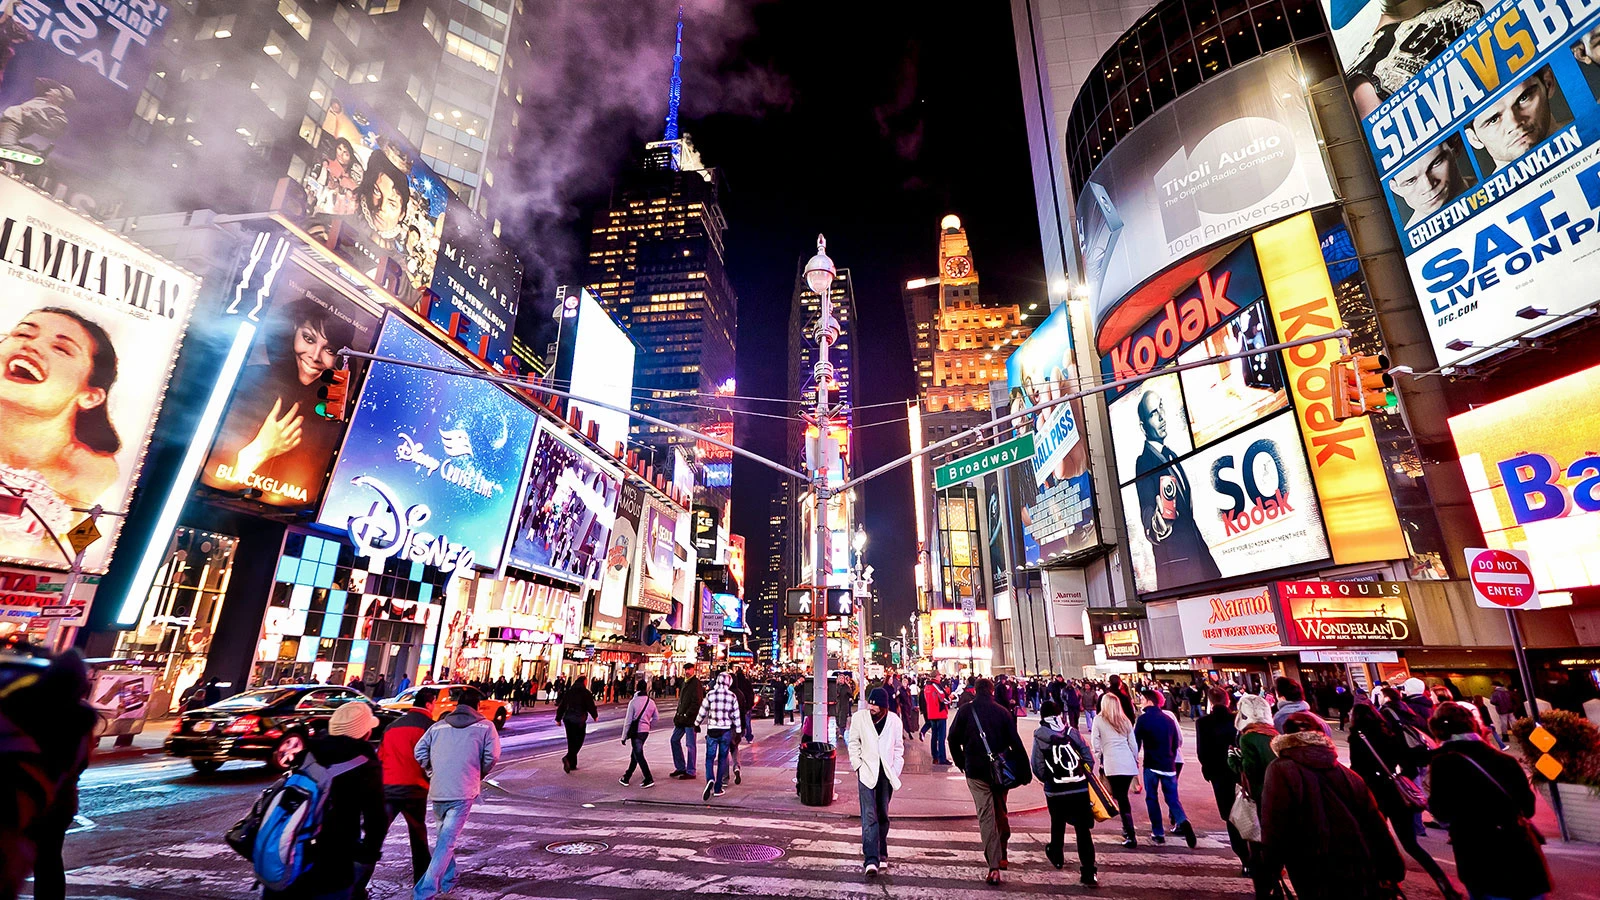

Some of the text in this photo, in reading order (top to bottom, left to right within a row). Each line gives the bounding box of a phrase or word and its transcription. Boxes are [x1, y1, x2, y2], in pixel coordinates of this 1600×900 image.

[96, 0, 154, 36] WARD
[128, 0, 168, 27] R!
[1369, 0, 1521, 124] WORLD MIDDLEWE
[1372, 58, 1485, 171] SILVA
[1461, 7, 1536, 92] VS
[1162, 134, 1281, 196] Tivoli Audio
[1164, 149, 1285, 208] The Original Radio Company
[1407, 197, 1471, 249] GRIFFIN
[1483, 126, 1583, 203] FRANKLIN
[1539, 153, 1593, 190] PRESENTED BY
[1168, 192, 1311, 257] 10th Anniversary
[7, 267, 25, 281] THE
[26, 274, 56, 290] SMASH
[116, 263, 180, 319] MIA!
[444, 243, 516, 316] MICHAEL
[1430, 267, 1500, 315] LIVE
[1504, 235, 1562, 276] ON
[447, 276, 507, 332] THE NEW ALBUM
[451, 295, 492, 334] DECEMBER
[1437, 300, 1479, 328] UFC.COM
[1110, 270, 1240, 392] Kodak
[1279, 296, 1366, 469] Kodak
[949, 446, 1019, 481] Broadway
[1032, 437, 1054, 473] HALL
[1049, 408, 1075, 451] PASS
[1209, 438, 1291, 521] SO
[1221, 488, 1296, 538] Kodak
[1285, 584, 1402, 596] MARQUIS
[1478, 560, 1519, 571] DO NOT
[501, 576, 571, 621] FOREVER
[1208, 589, 1274, 625] Marriot
[1486, 585, 1524, 597] ENTER
[1103, 621, 1138, 632] MARQUIS
[1202, 623, 1279, 639] NEW YORK MARQ
